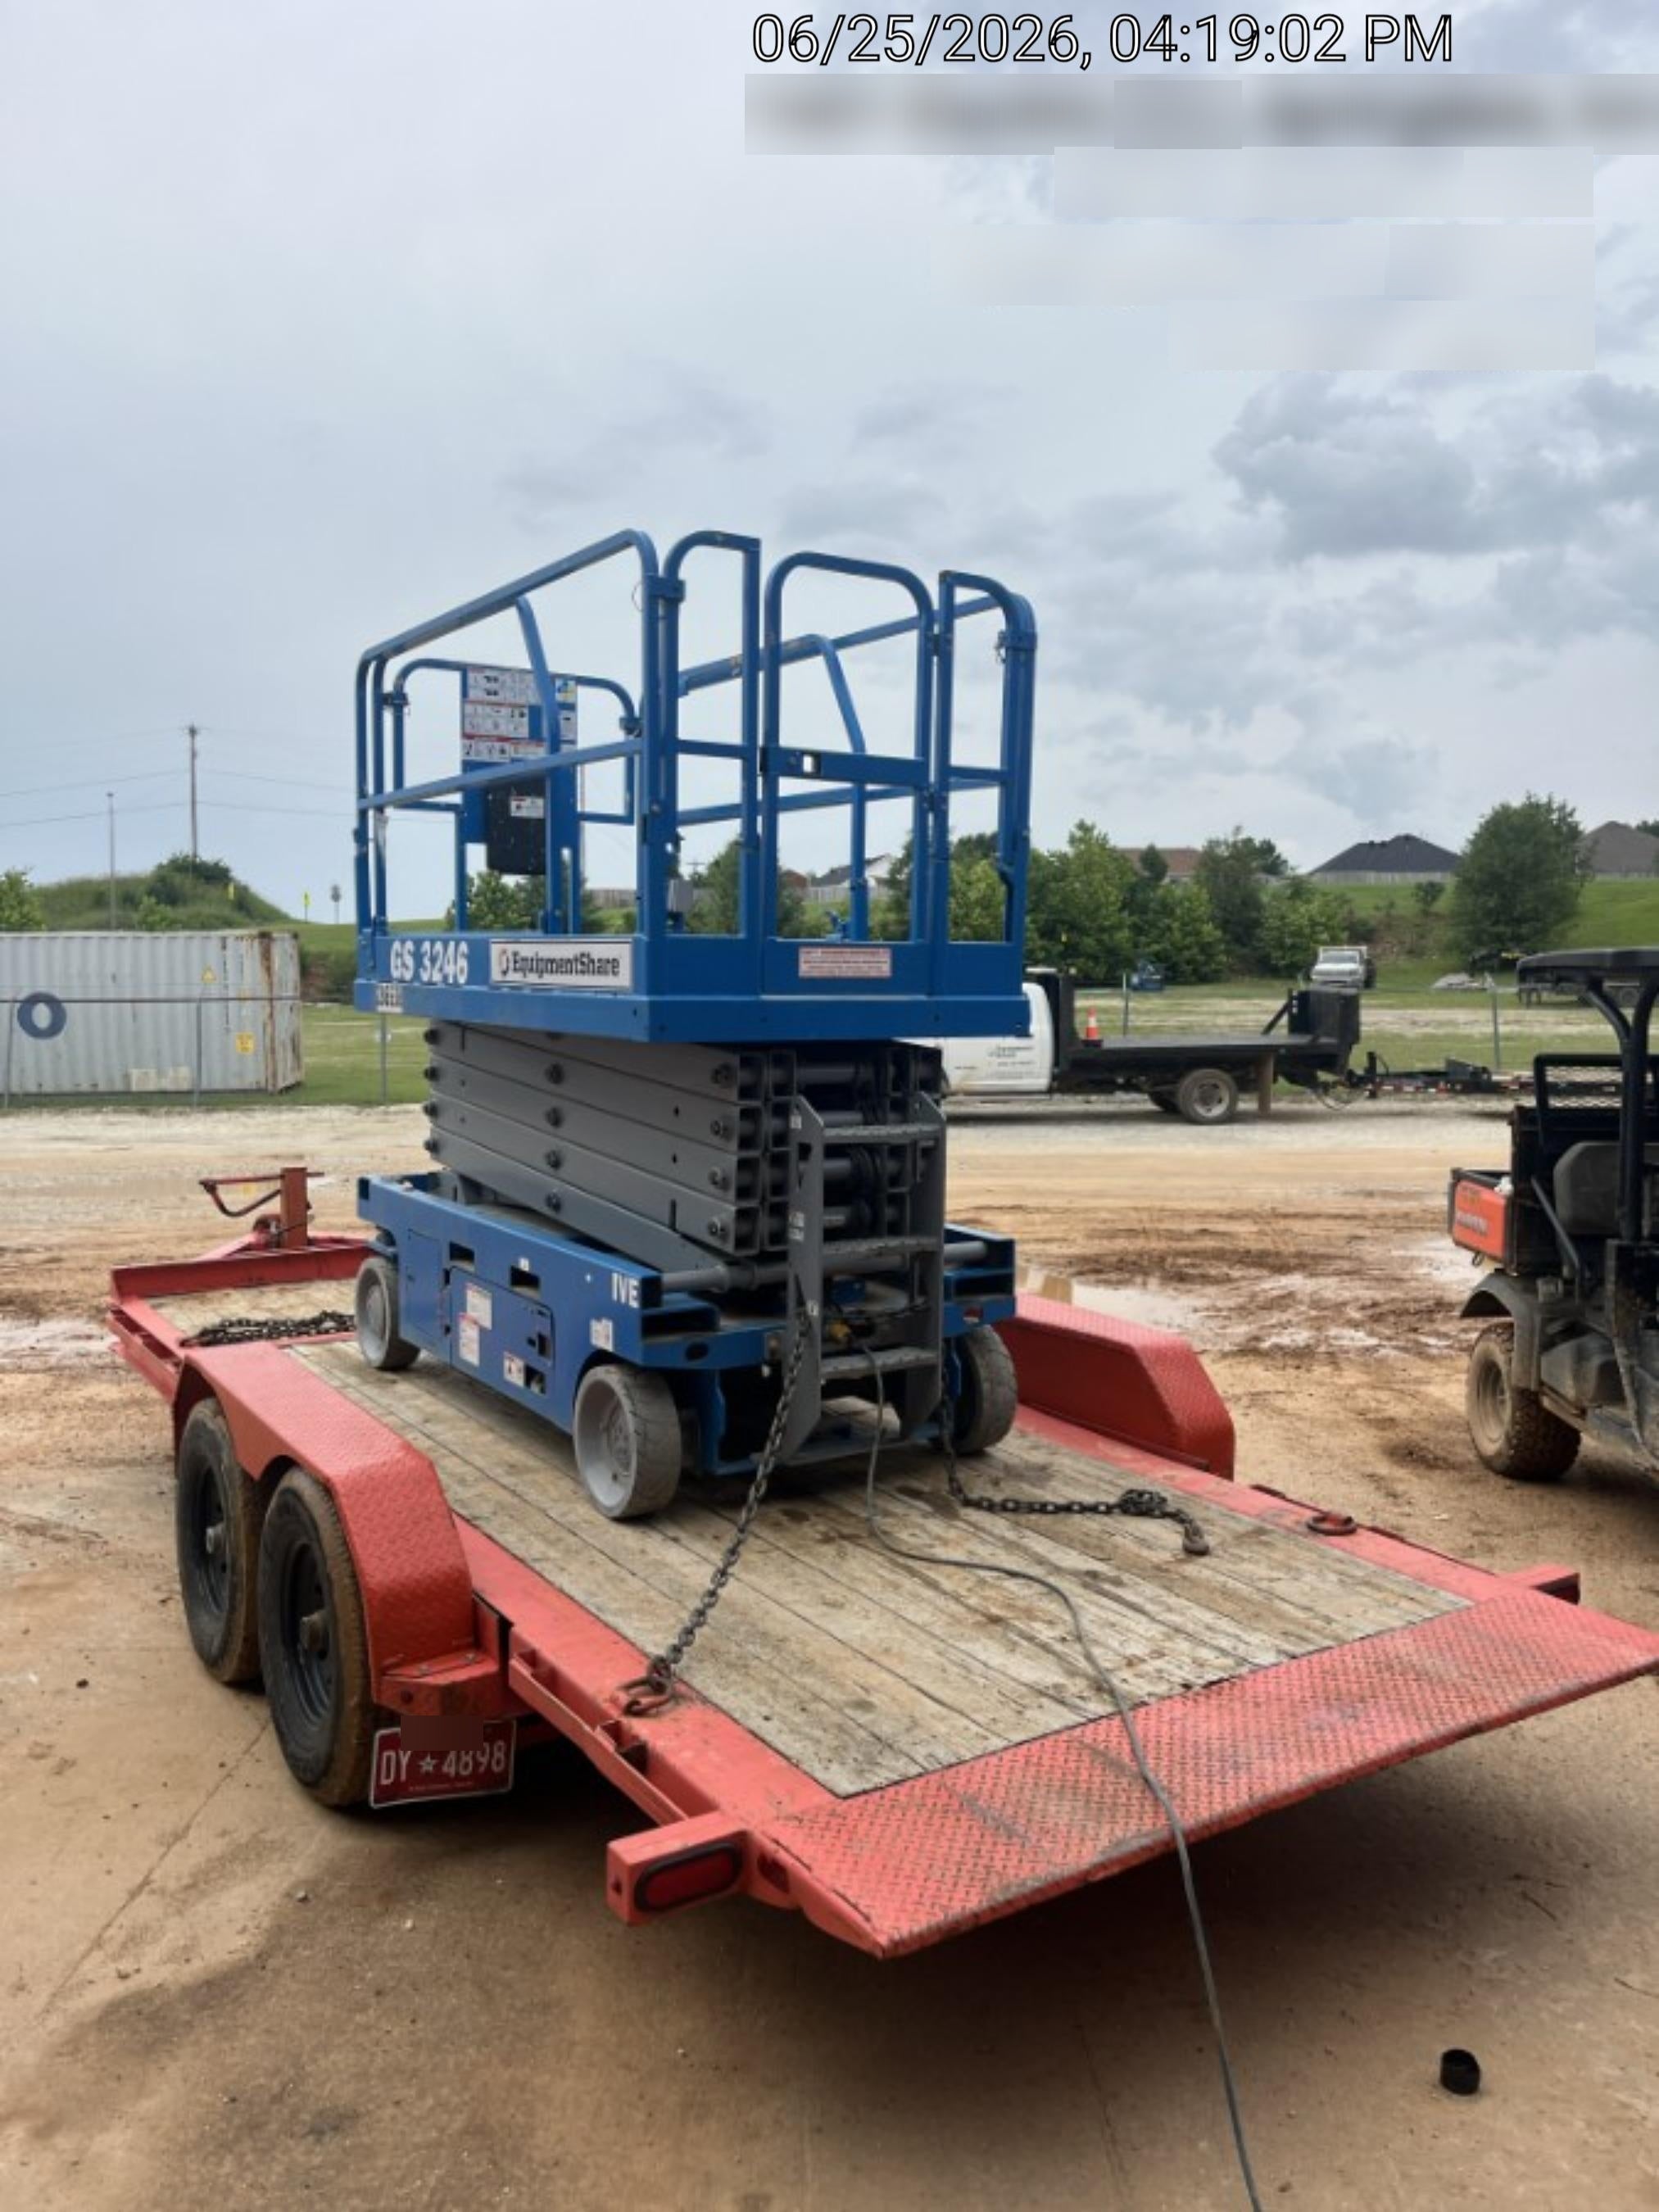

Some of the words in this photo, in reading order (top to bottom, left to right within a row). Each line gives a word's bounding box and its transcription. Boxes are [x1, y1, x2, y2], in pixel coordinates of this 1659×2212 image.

[390, 940, 415, 981] GS
[419, 941, 469, 984] 3246
[510, 950, 620, 979] EquipmentShare
[379, 1749, 411, 1786] DY
[441, 1739, 507, 1779] 4898
